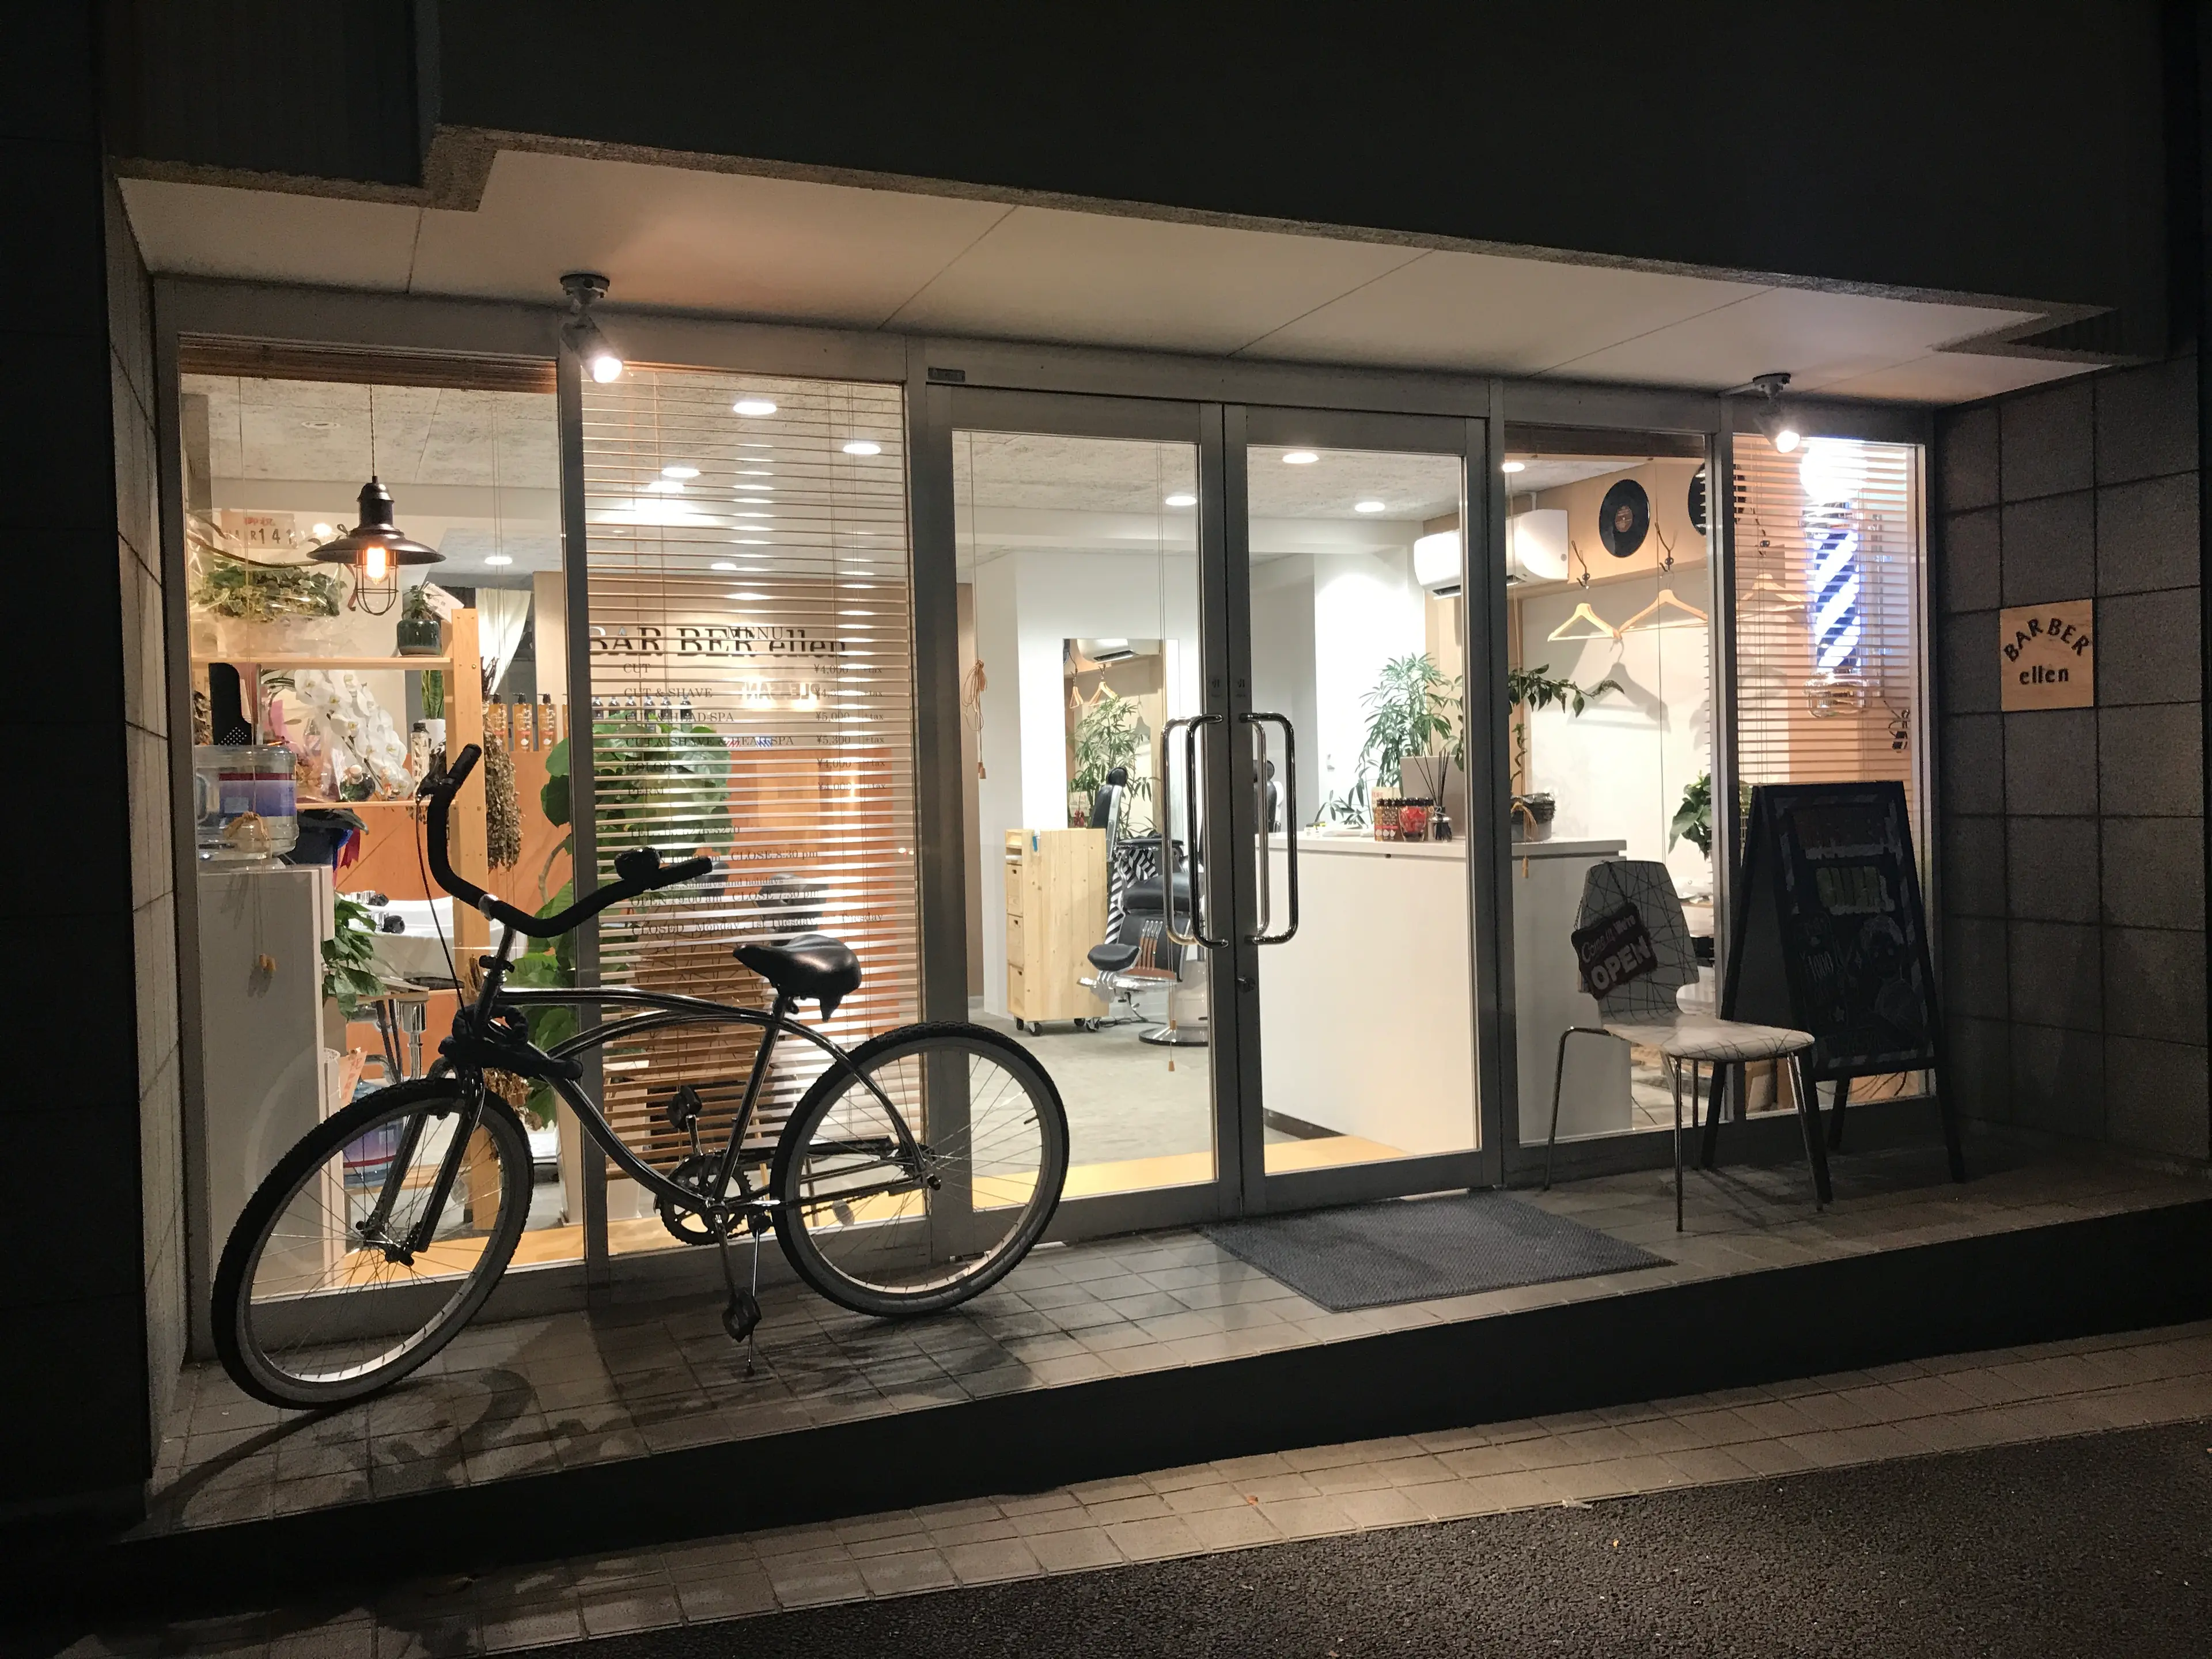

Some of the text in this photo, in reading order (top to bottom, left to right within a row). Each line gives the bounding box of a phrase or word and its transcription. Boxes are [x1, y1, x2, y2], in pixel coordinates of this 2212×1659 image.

[726, 626, 783, 640] MENU
[768, 629, 849, 658] ellen
[623, 663, 651, 673] CUT
[2019, 665, 2069, 685] ellen
[624, 688, 652, 698] CUT
[654, 688, 666, 698] &
[668, 687, 713, 698] SHAVE
[625, 712, 652, 722] CUT
[657, 712, 666, 722] &
[709, 712, 734, 722] SPA
[816, 711, 850, 722] ¥5,000
[626, 737, 652, 747] CUT
[771, 736, 794, 746] SPA
[816, 735, 851, 745] ¥5,300
[731, 850, 772, 861] CLOSE
[776, 850, 798, 859] 8:30
[802, 850, 819, 859] pm
[732, 892, 774, 902] CLOSE
[632, 923, 684, 935] CLOSED
[1590, 935, 1651, 990] OPEN
